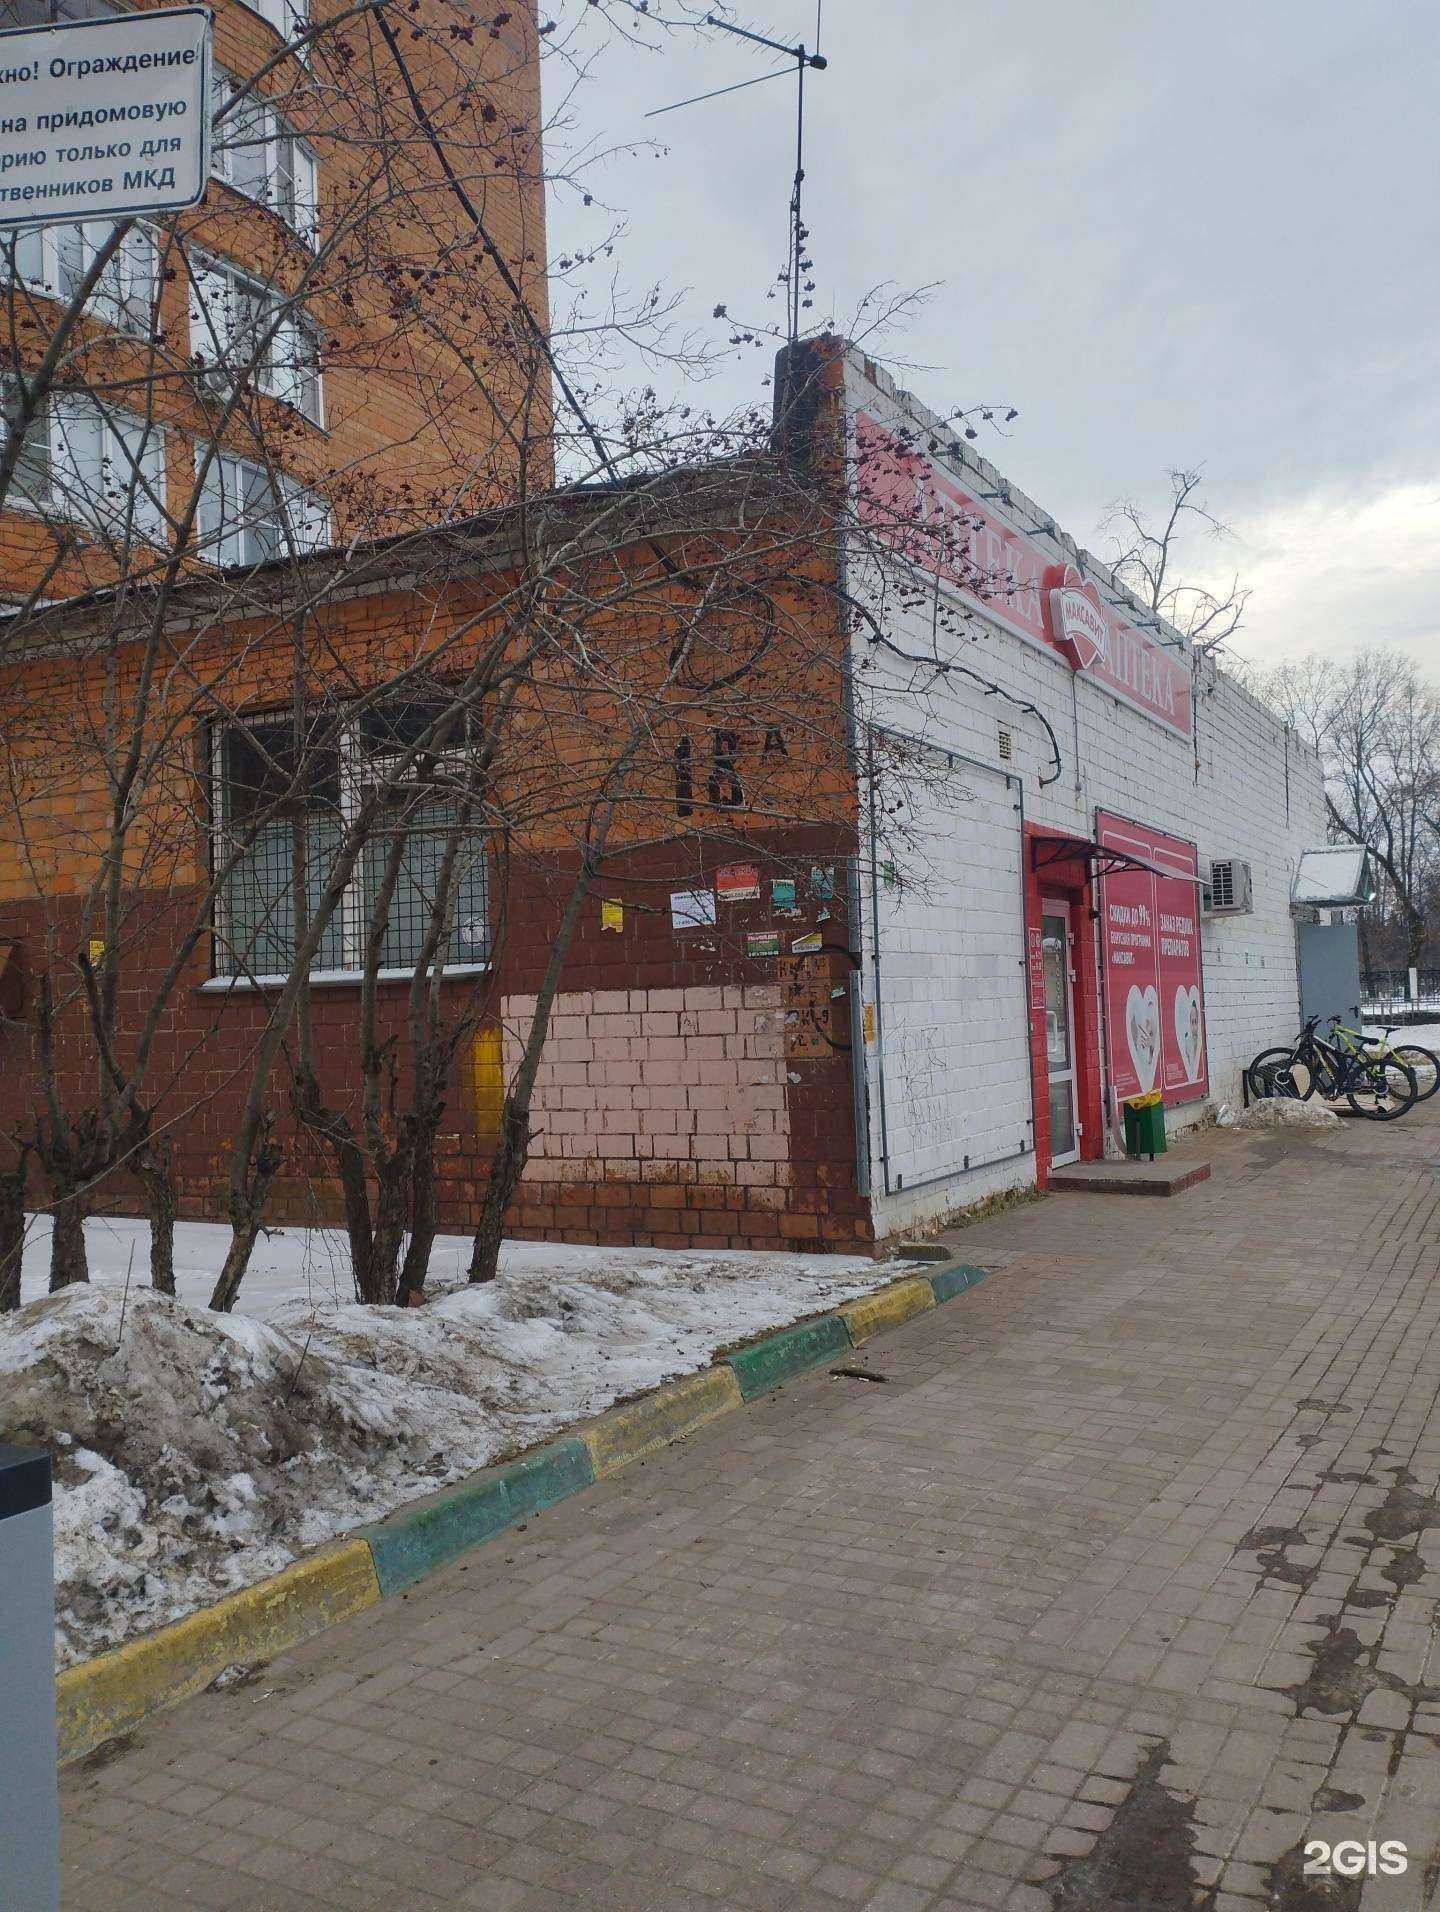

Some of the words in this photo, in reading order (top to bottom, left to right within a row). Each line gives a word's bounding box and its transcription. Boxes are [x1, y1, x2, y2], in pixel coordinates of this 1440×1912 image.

[49, 48, 195, 79] Ограждение
[1, 117, 27, 134] на
[36, 100, 187, 133] придомовую
[56, 142, 131, 163] только
[139, 137, 182, 157] для
[123, 167, 175, 190] МКД
[1064, 601, 1105, 643] МАКСАВИТ
